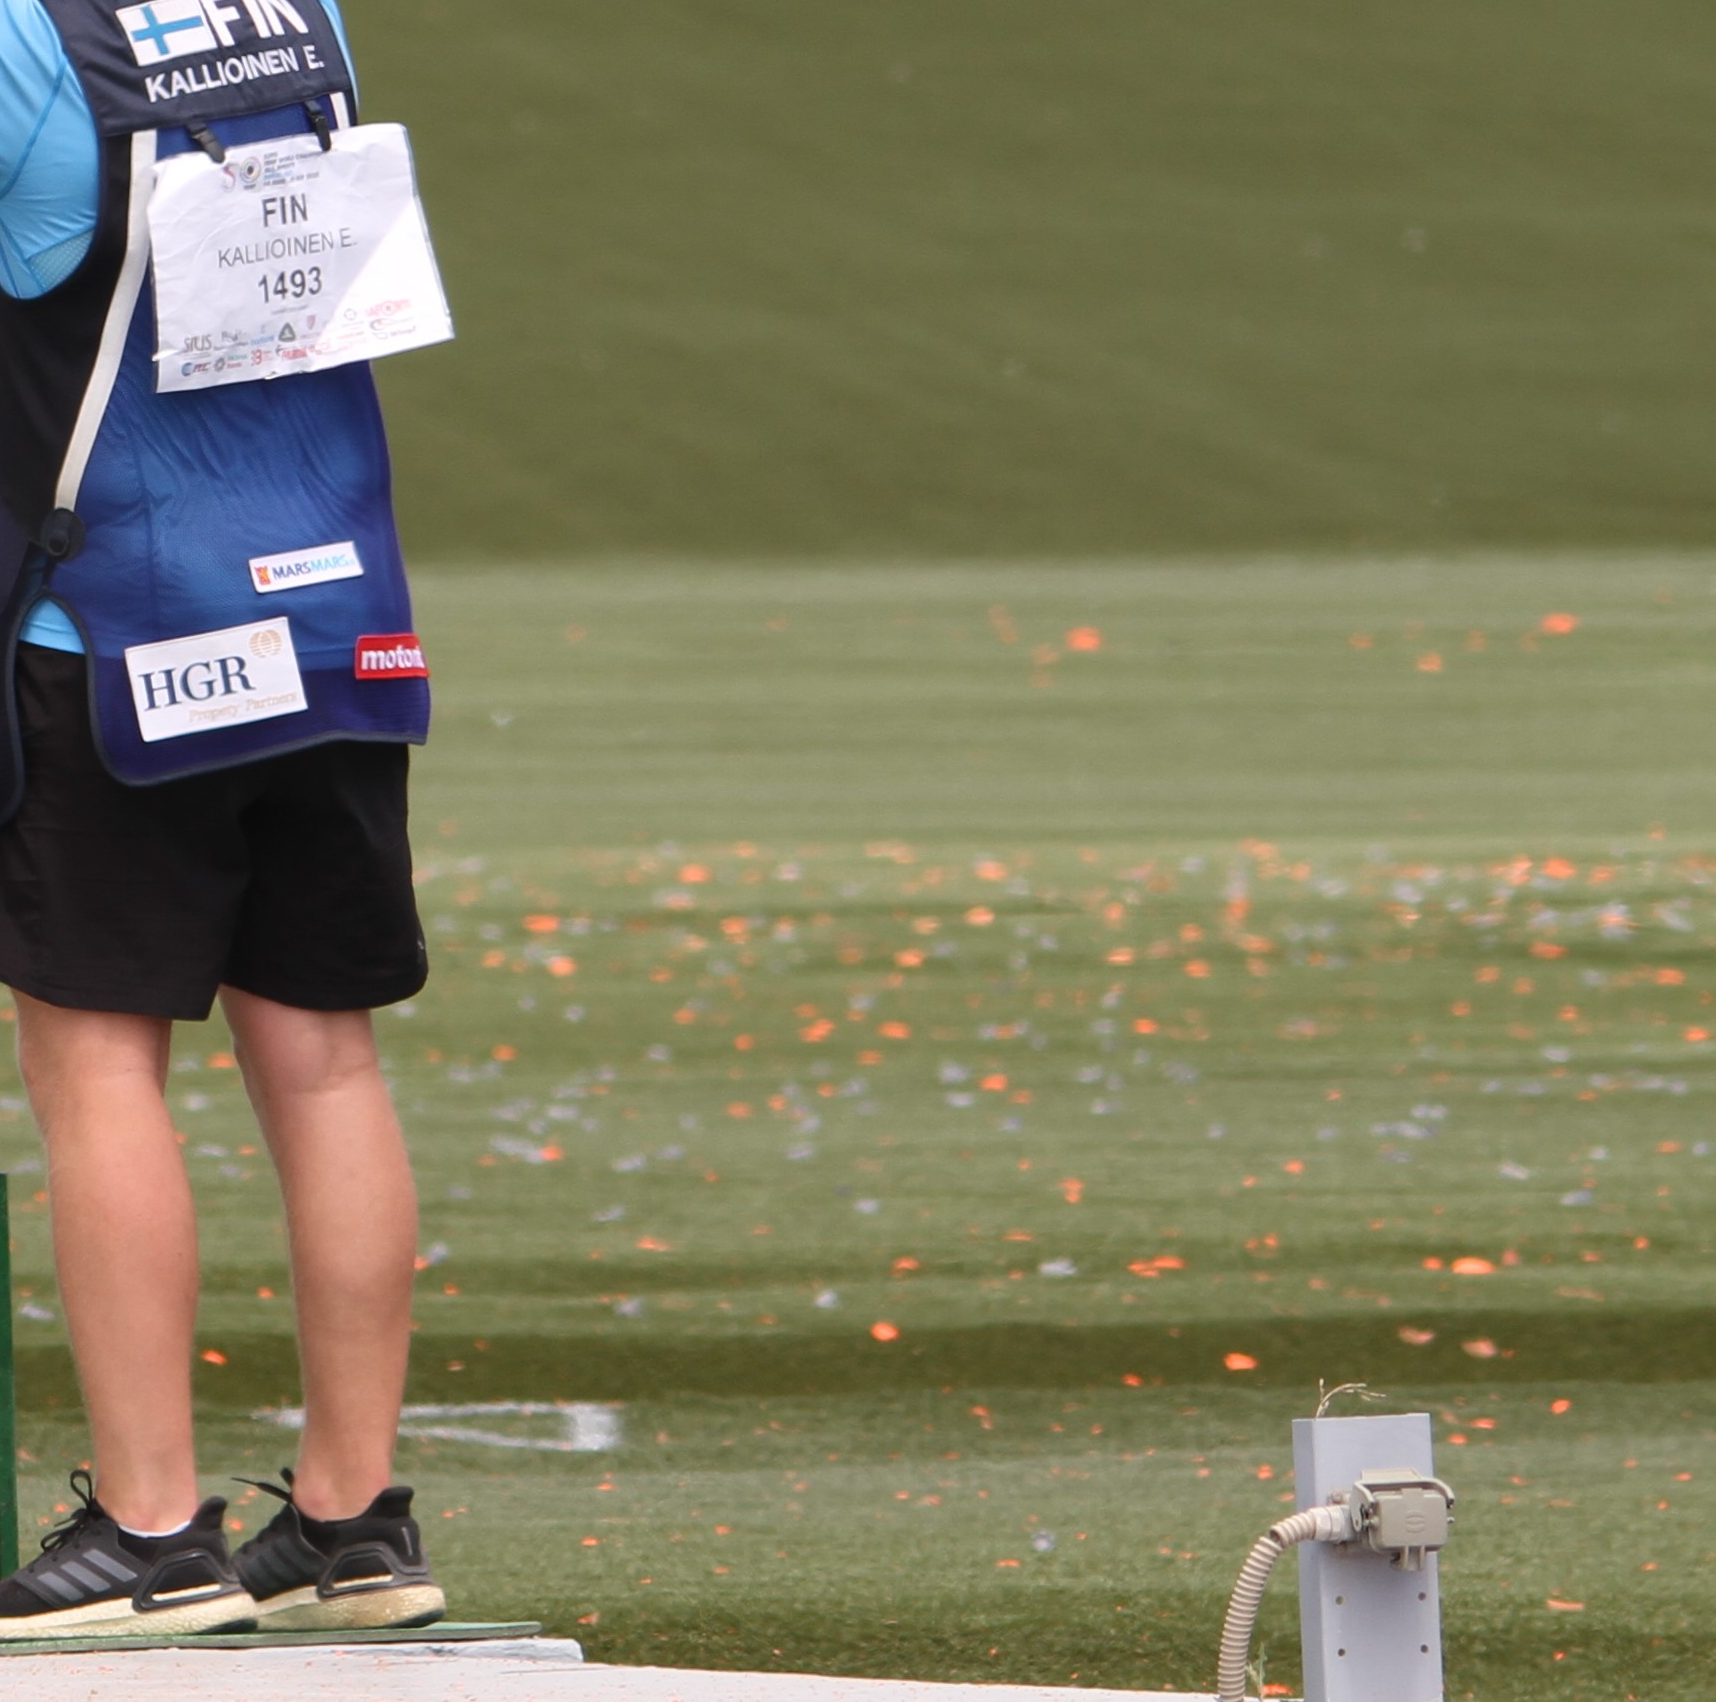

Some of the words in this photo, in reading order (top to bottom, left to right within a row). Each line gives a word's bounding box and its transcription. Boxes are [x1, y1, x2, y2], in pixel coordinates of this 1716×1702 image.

[145, 47, 299, 103] KALLIOINEN
[303, 45, 325, 69] E.
[261, 193, 308, 228] FIN
[218, 230, 334, 268] KALLIOINEN
[339, 227, 358, 248] E.
[258, 266, 322, 303] 1493
[138, 655, 256, 712] HGR
